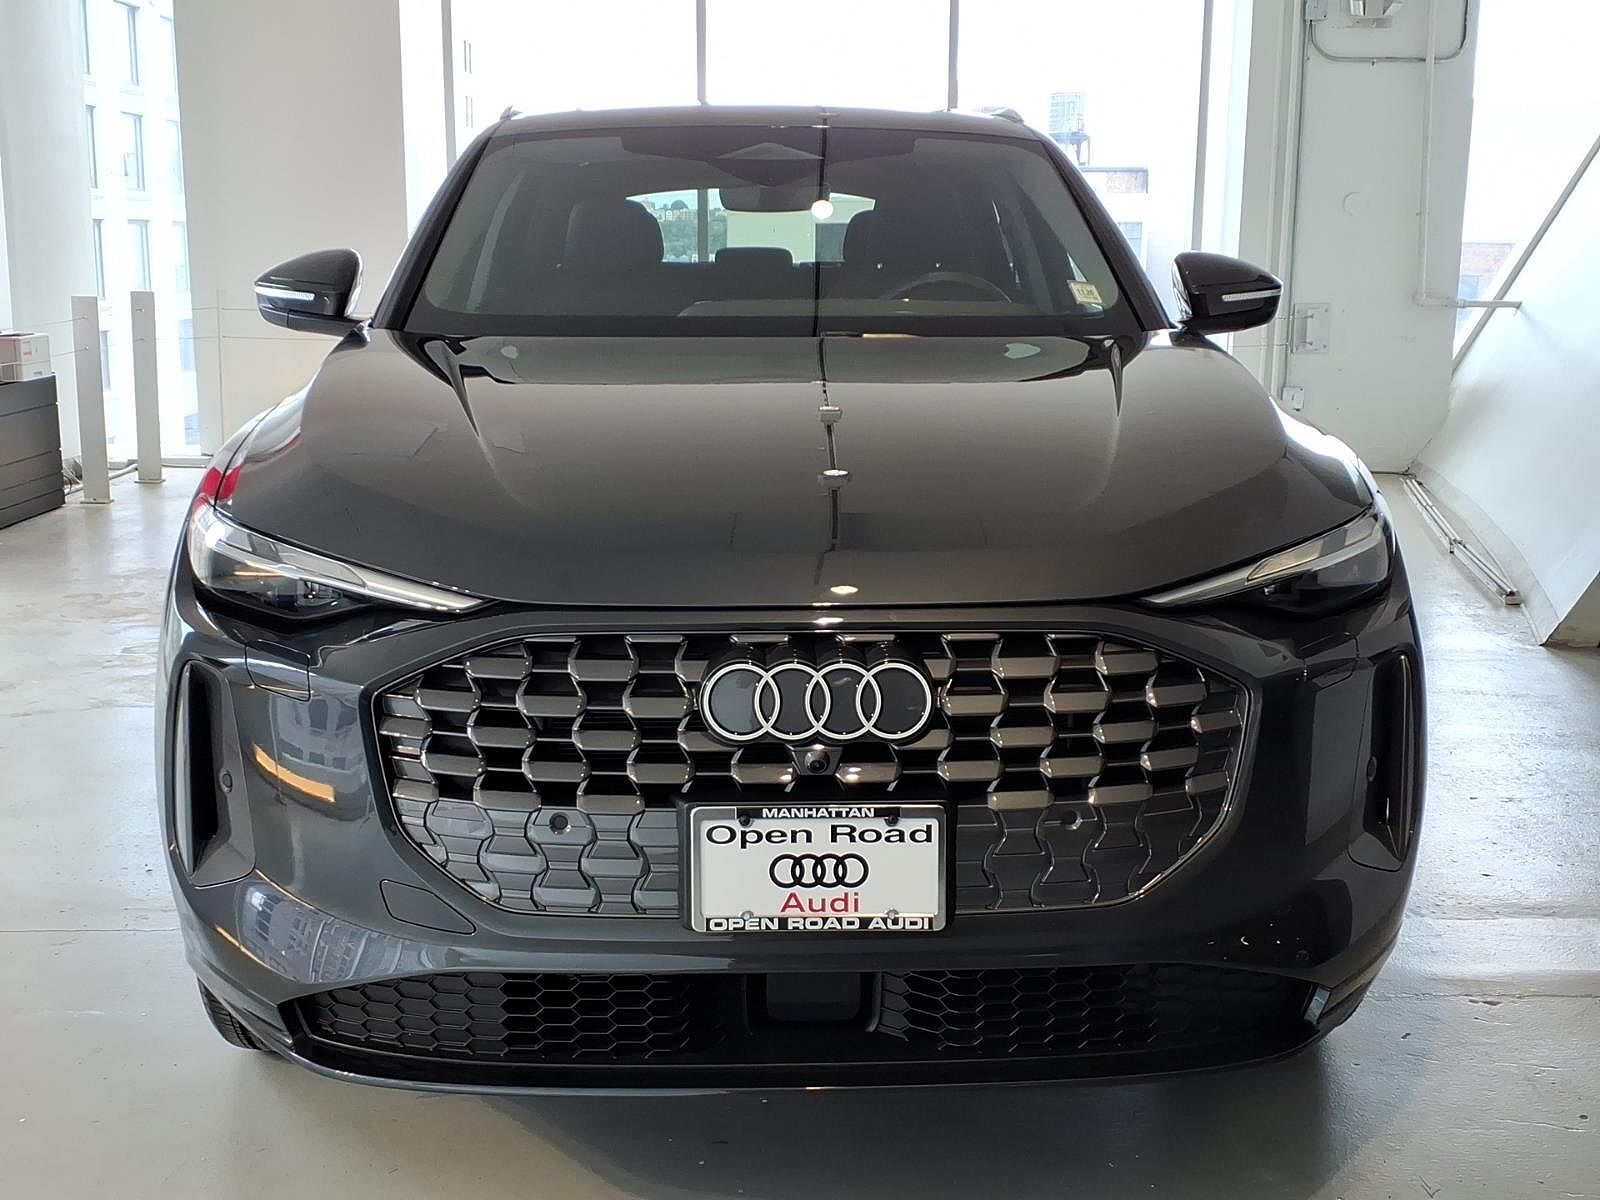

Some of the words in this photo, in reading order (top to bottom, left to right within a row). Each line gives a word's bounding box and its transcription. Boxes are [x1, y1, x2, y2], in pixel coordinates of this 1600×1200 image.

[762, 807, 875, 818] MANHATTAN
[706, 824, 813, 849] Open
[830, 824, 933, 843] Road
[780, 892, 859, 913] Audi
[709, 917, 779, 931] OPEN
[787, 917, 860, 930] ROAD
[868, 917, 929, 930] AUDI
